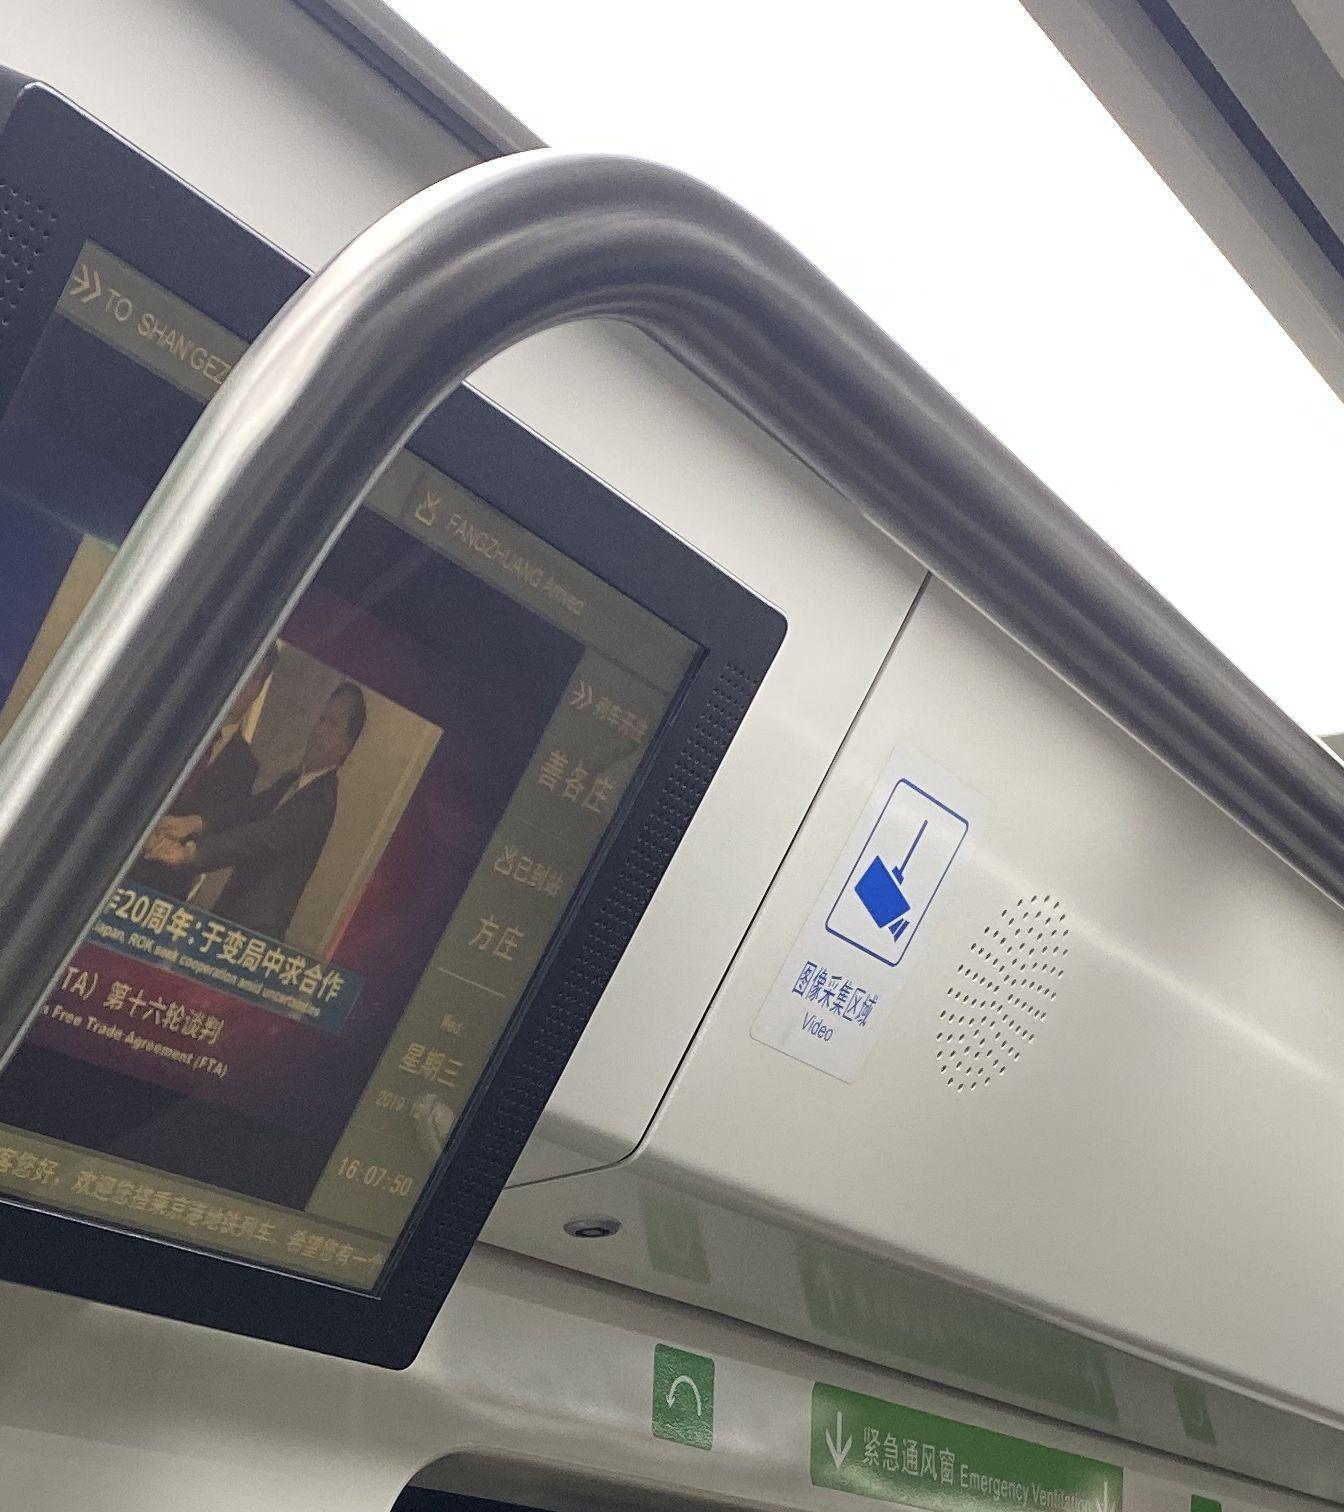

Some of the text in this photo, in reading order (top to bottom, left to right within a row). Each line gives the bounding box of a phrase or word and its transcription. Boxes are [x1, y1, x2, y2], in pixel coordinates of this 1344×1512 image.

[103, 288, 133, 323] TO
[447, 513, 544, 589] FANGZHUANG
[538, 751, 616, 814] 善各庄
[468, 914, 526, 962] 方庄
[792, 960, 879, 1027] 图像采集区域
[51, 1003, 83, 1027] Free
[86, 1015, 123, 1042] Trade
[123, 1029, 194, 1065] Agreement
[801, 1011, 834, 1042] Video
[398, 1041, 464, 1089] 星期三
[336, 1155, 414, 1197] 16:07:50
[862, 1425, 956, 1486] 紧急通风窗
[959, 1463, 1030, 1508] Emergency
